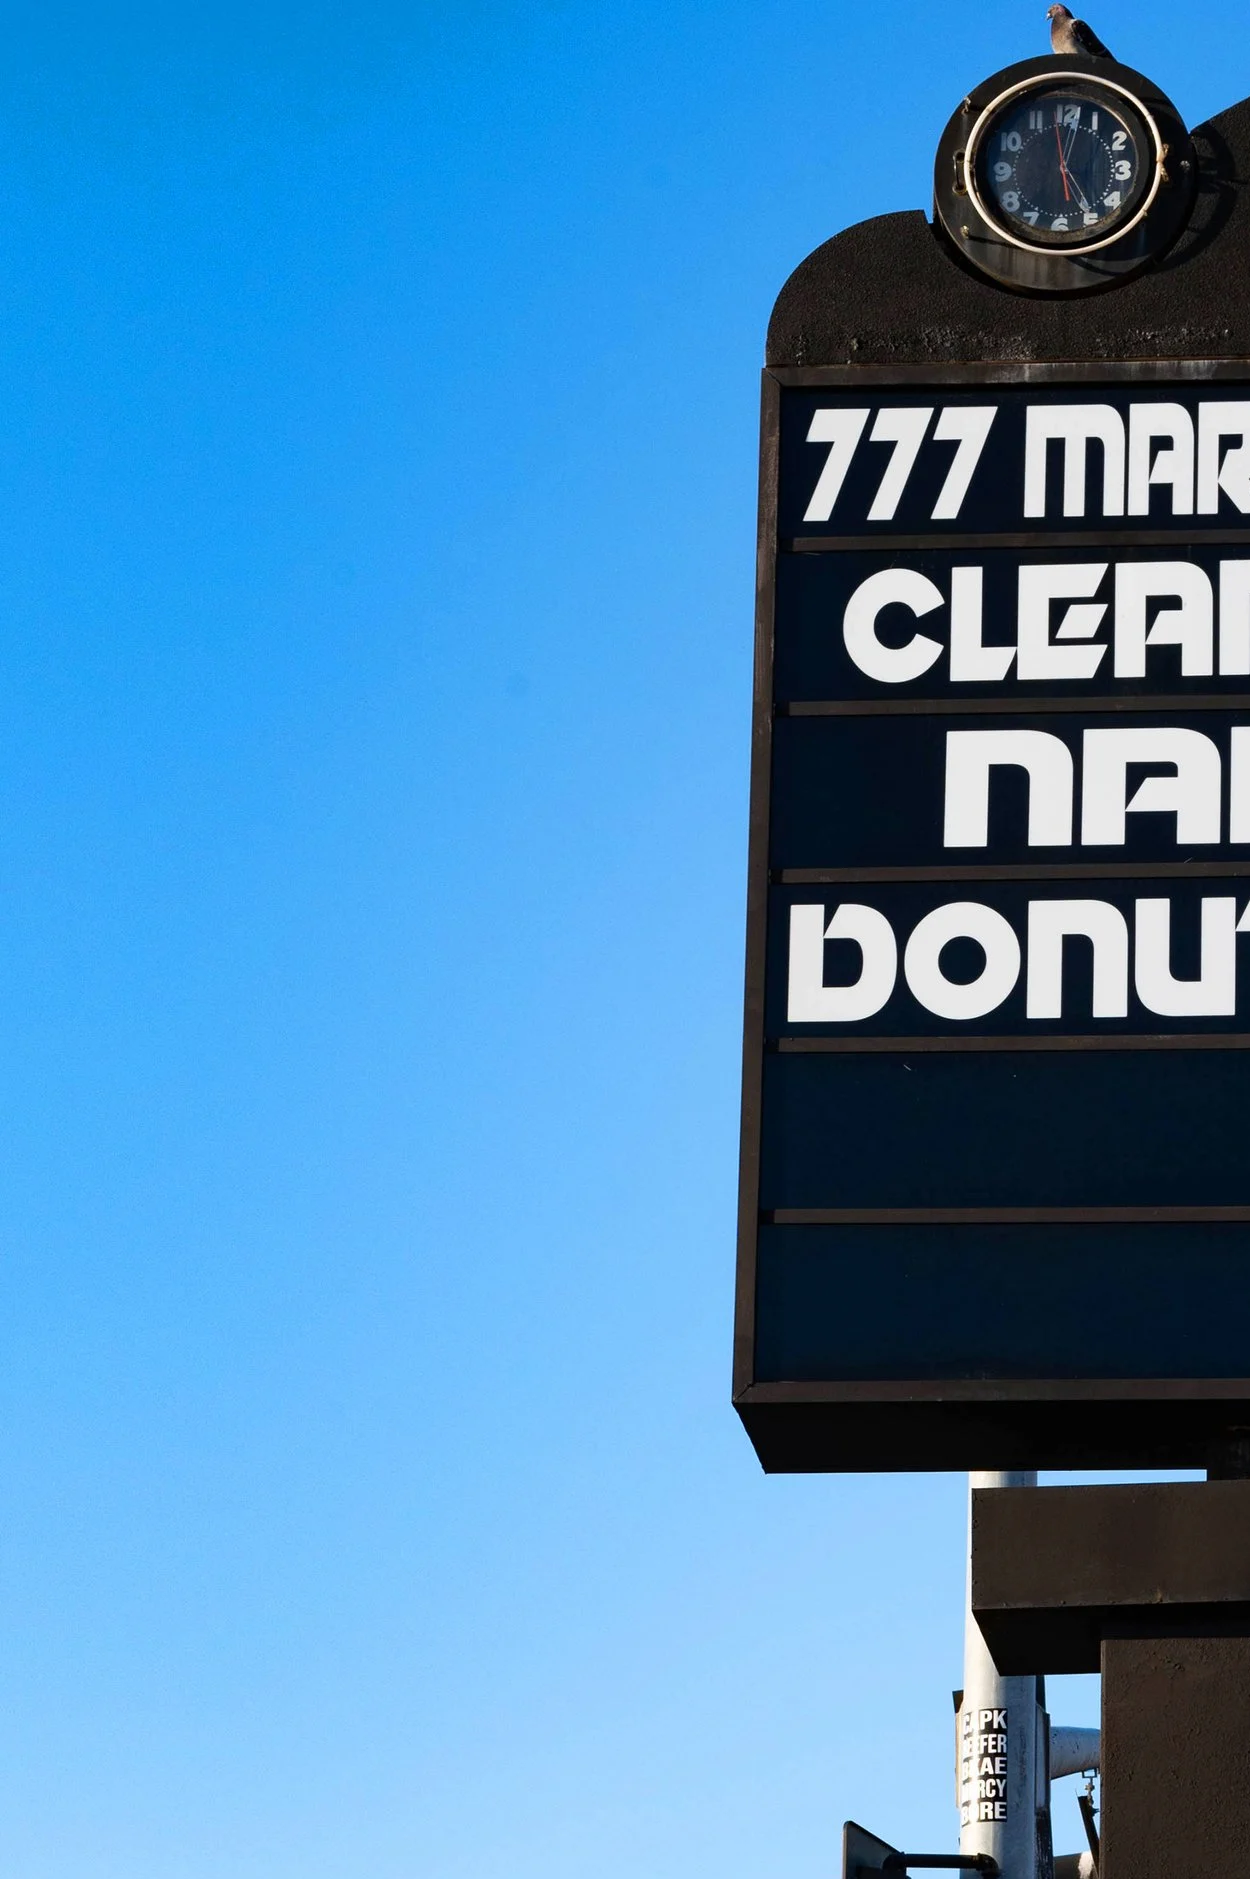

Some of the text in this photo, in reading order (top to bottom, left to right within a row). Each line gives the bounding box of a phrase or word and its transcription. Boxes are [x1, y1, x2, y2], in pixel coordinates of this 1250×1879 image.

[1029, 110, 1043, 130] 11
[1056, 104, 1079, 127] 12
[1091, 111, 1098, 130] 1
[1001, 131, 1022, 152] 10
[1112, 131, 1127, 150] 2
[993, 162, 1012, 182] 9
[1115, 160, 1132, 181] 3
[1001, 191, 1020, 213] 8
[1103, 191, 1121, 210] 4
[1023, 211, 1039, 226] 7
[1051, 217, 1069, 231] 6
[803, 406, 998, 522] 777
